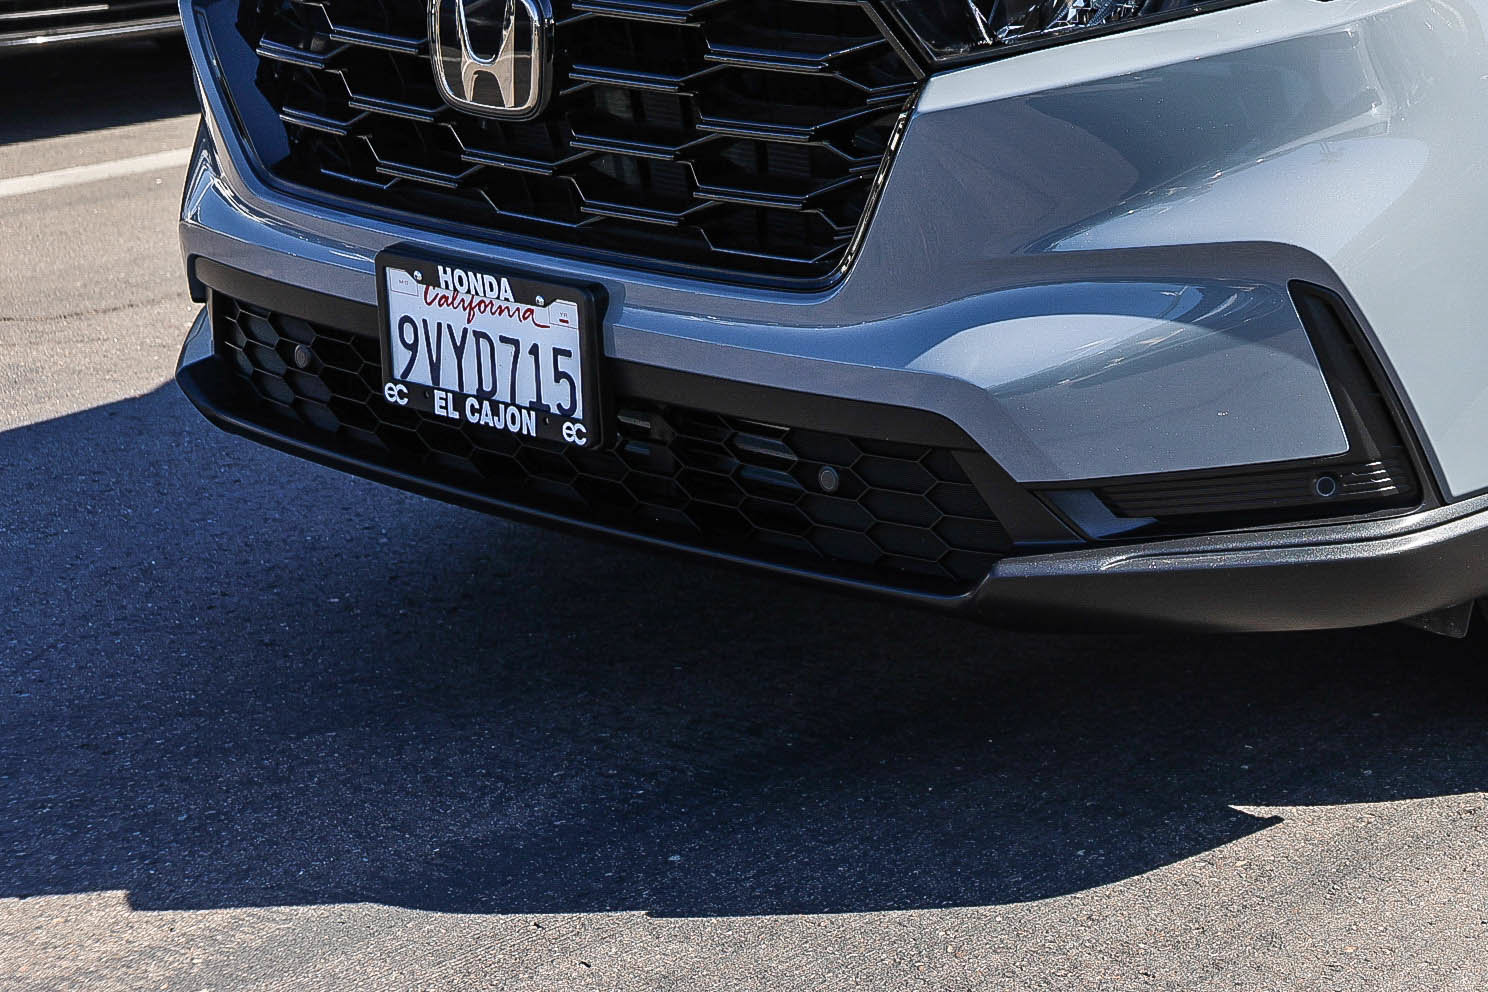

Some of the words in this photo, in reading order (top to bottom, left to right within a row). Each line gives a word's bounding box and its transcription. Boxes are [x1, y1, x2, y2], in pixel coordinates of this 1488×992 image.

[437, 265, 515, 302] HONDA
[423, 285, 551, 328] California
[398, 314, 577, 417] 9VYD715
[434, 389, 460, 419] EL
[465, 397, 537, 437] CAJON
